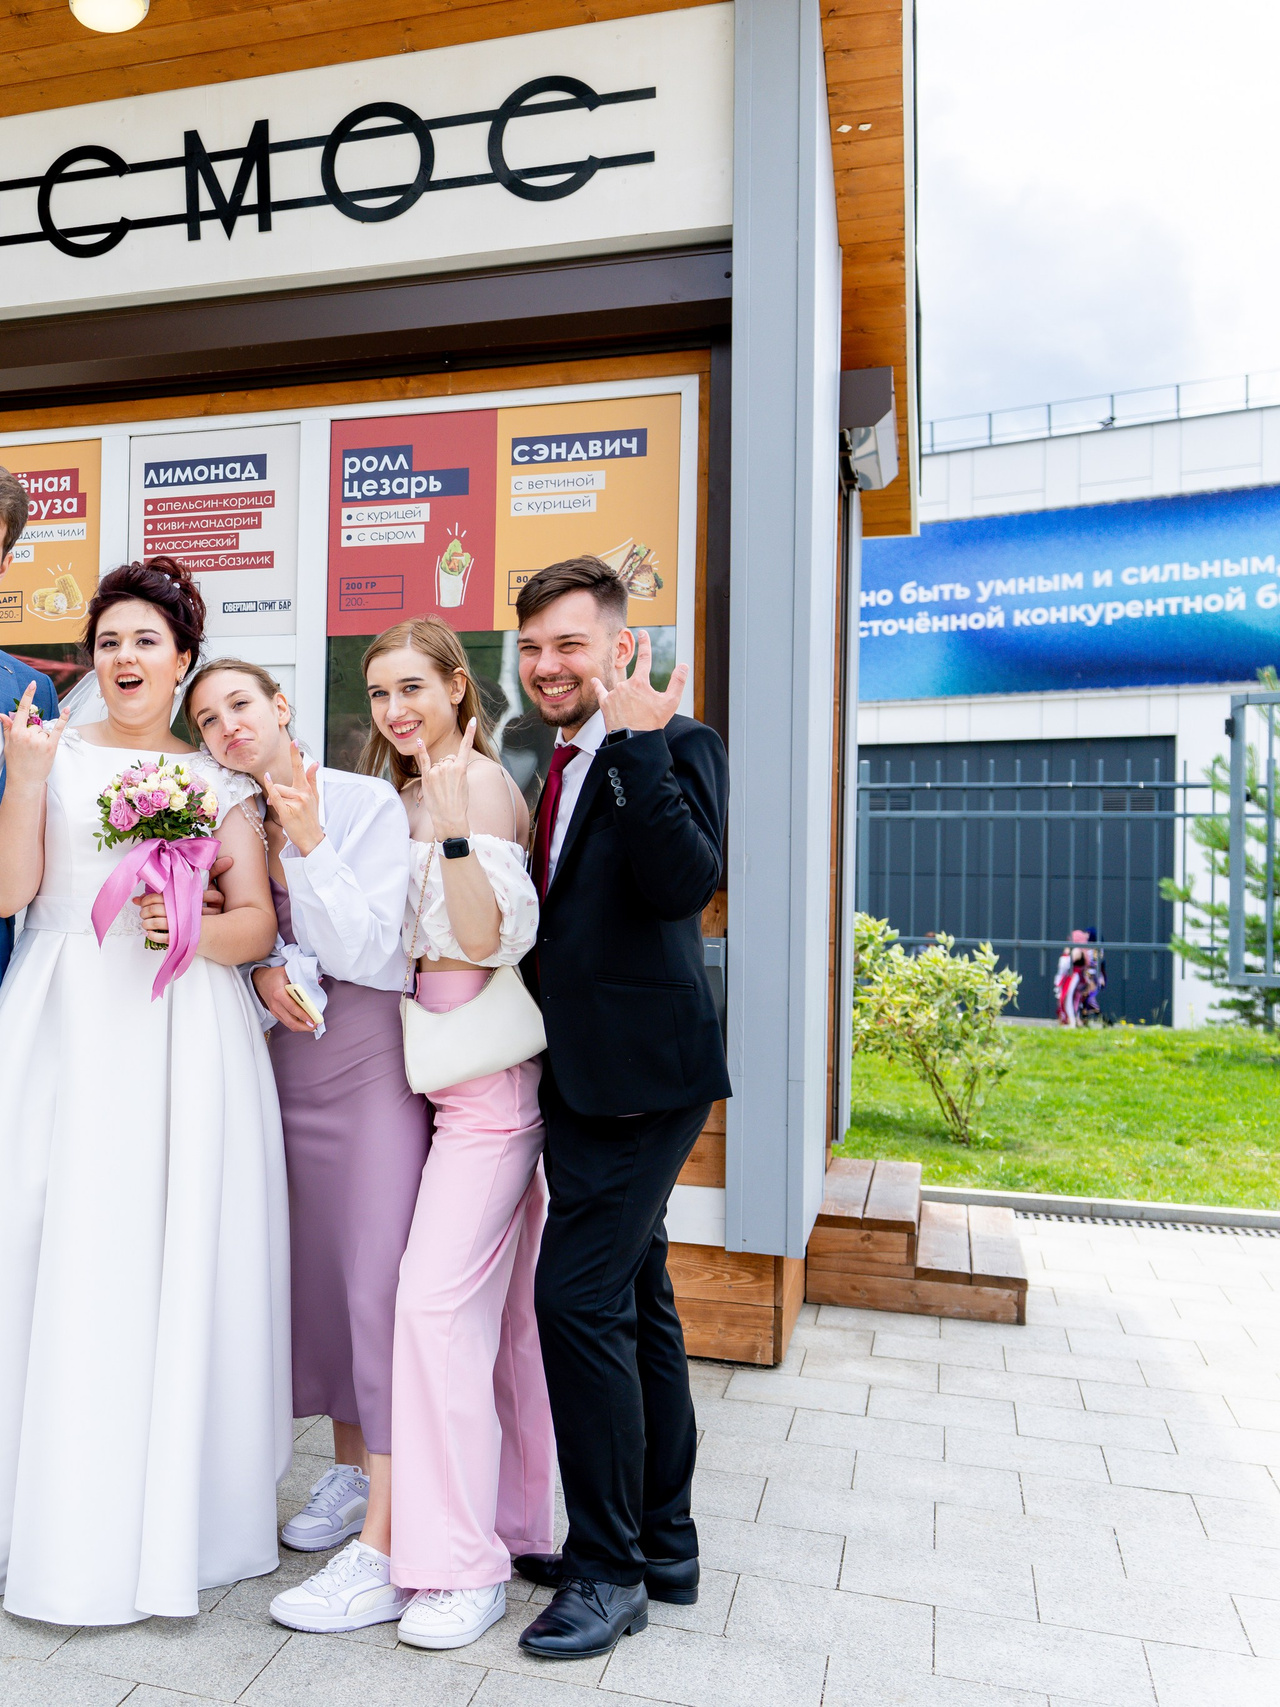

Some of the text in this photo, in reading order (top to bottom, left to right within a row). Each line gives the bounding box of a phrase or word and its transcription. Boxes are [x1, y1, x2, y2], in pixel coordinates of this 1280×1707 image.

[144, 461, 259, 486] лимонад
[344, 453, 410, 479] ролл
[17, 473, 71, 494] ёная
[343, 475, 443, 499] цезарь
[514, 473, 595, 491] с ветчиной
[156, 495, 273, 512] апельсин-корица
[513, 495, 591, 513] с курицей
[355, 506, 422, 523] с курицей
[156, 516, 259, 532] киви-мандарин
[57, 528, 85, 538] чили
[357, 530, 417, 543] с сыром
[154, 534, 237, 551] классический
[176, 554, 272, 569] бника-базилик
[345, 581, 362, 590] 200
[516, 575, 529, 583] 80
[860, 588, 894, 608] но
[900, 580, 971, 605] быть
[976, 571, 1084, 604] умным
[1092, 568, 1113, 589] и
[859, 604, 1006, 638] сточённой
[1012, 585, 1247, 628] конкурентной
